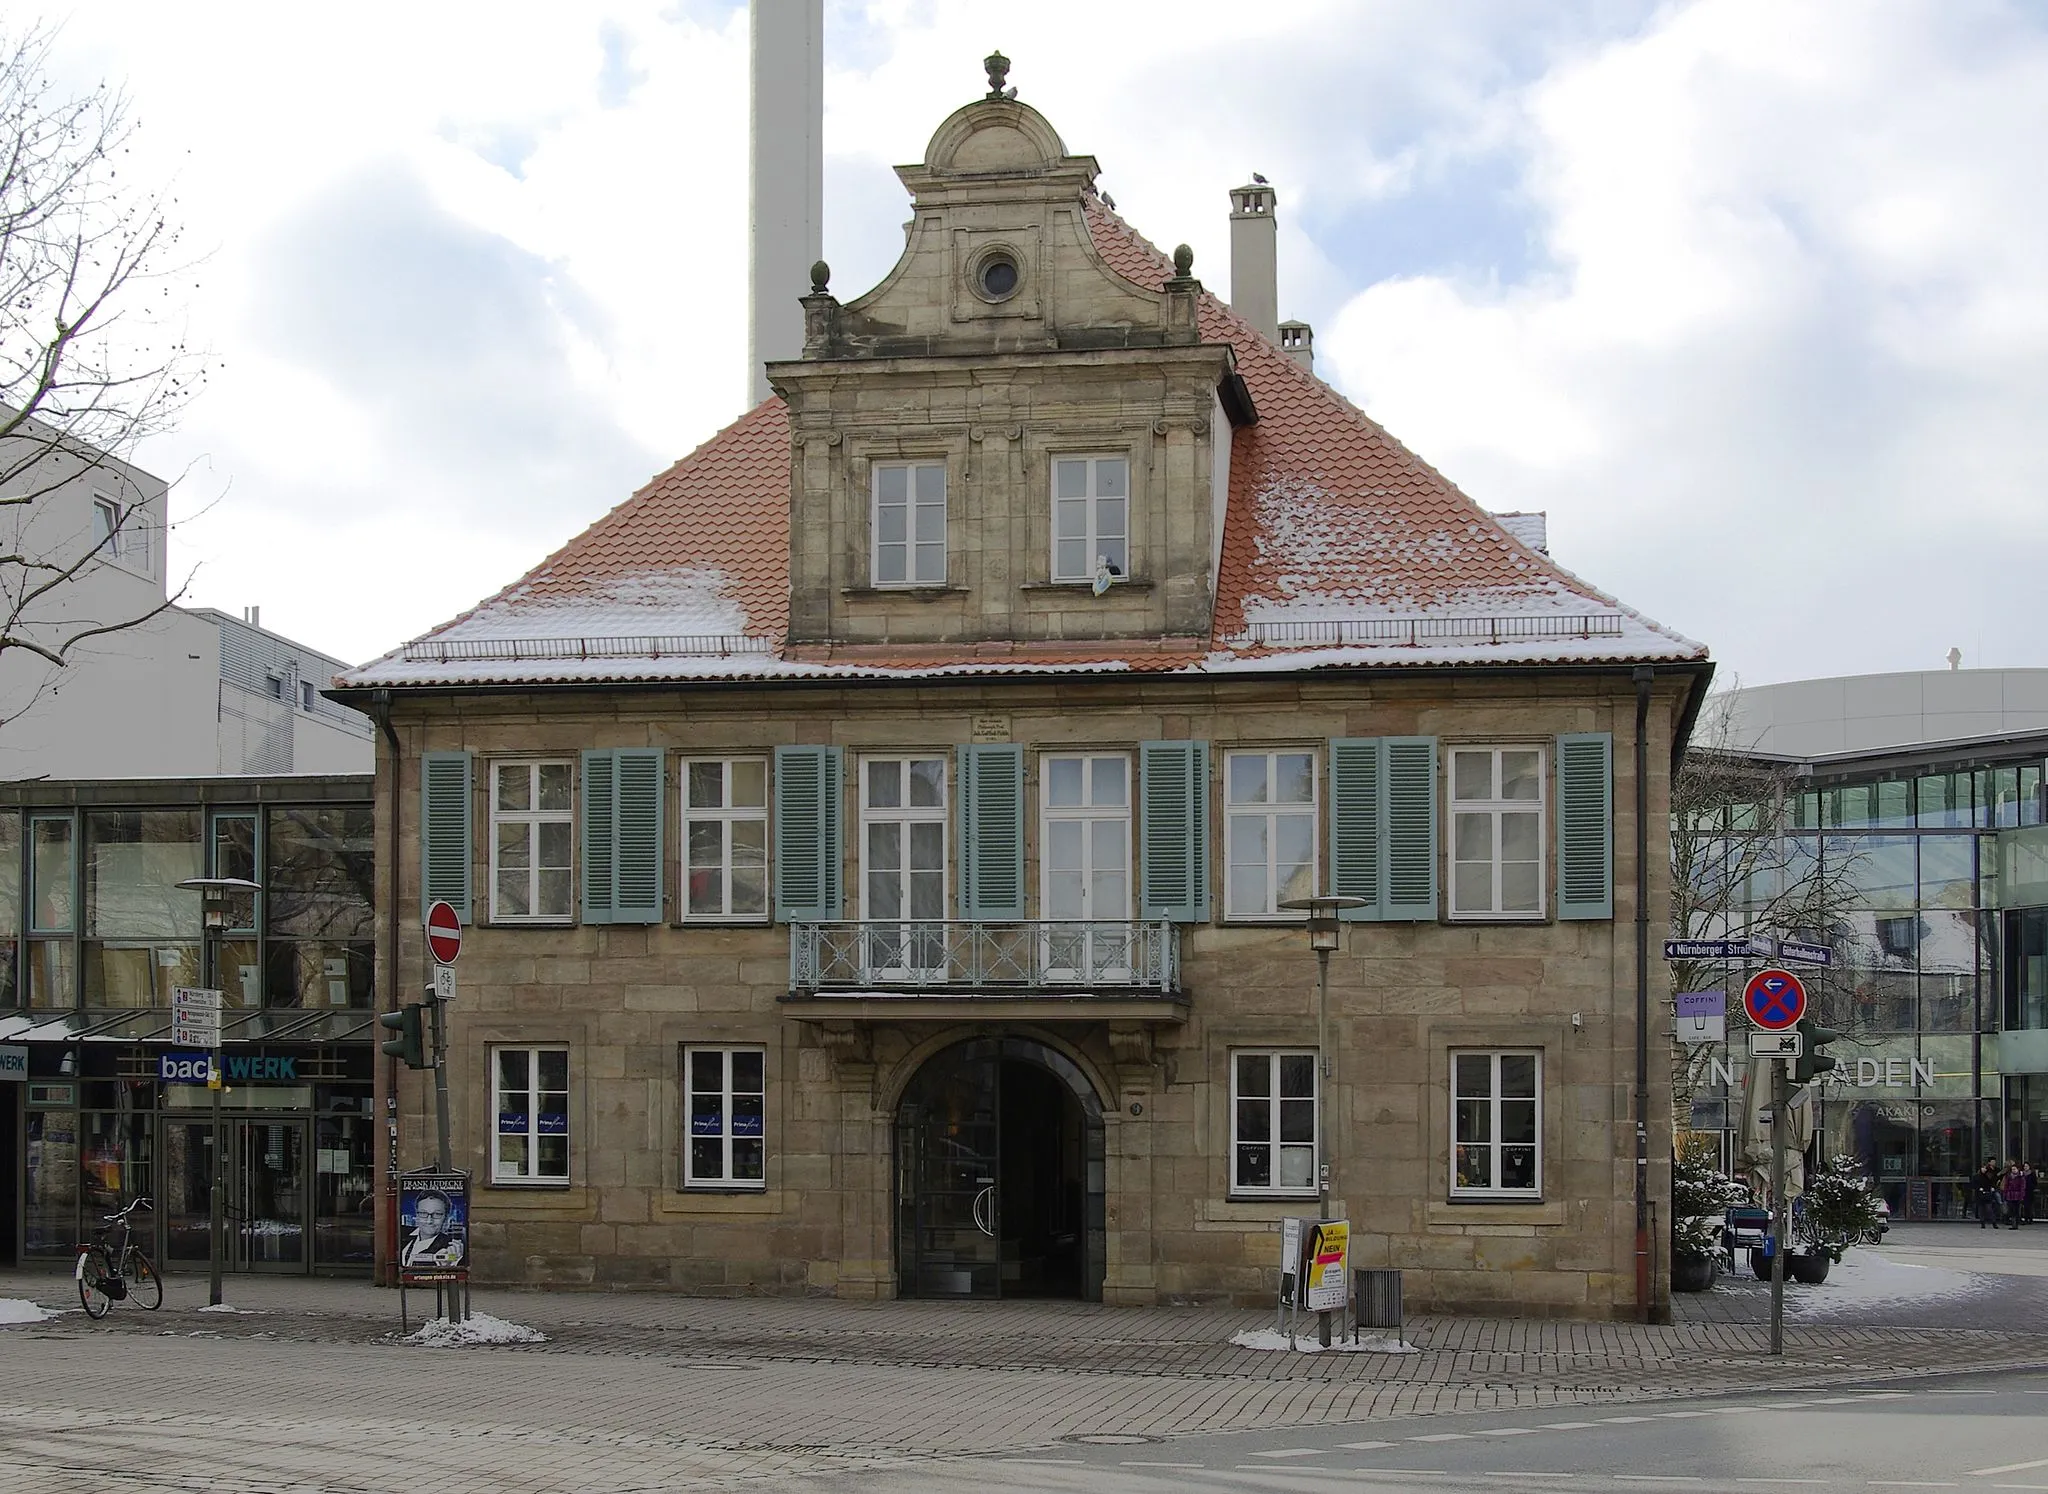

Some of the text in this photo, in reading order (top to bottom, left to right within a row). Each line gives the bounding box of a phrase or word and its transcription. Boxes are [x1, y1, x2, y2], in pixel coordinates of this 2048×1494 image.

[1676, 943, 1724, 957] Nürnberger
[1727, 943, 1750, 955] Straß
[228, 1056, 296, 1080] WERK
[403, 1180, 428, 1188] FRANK
